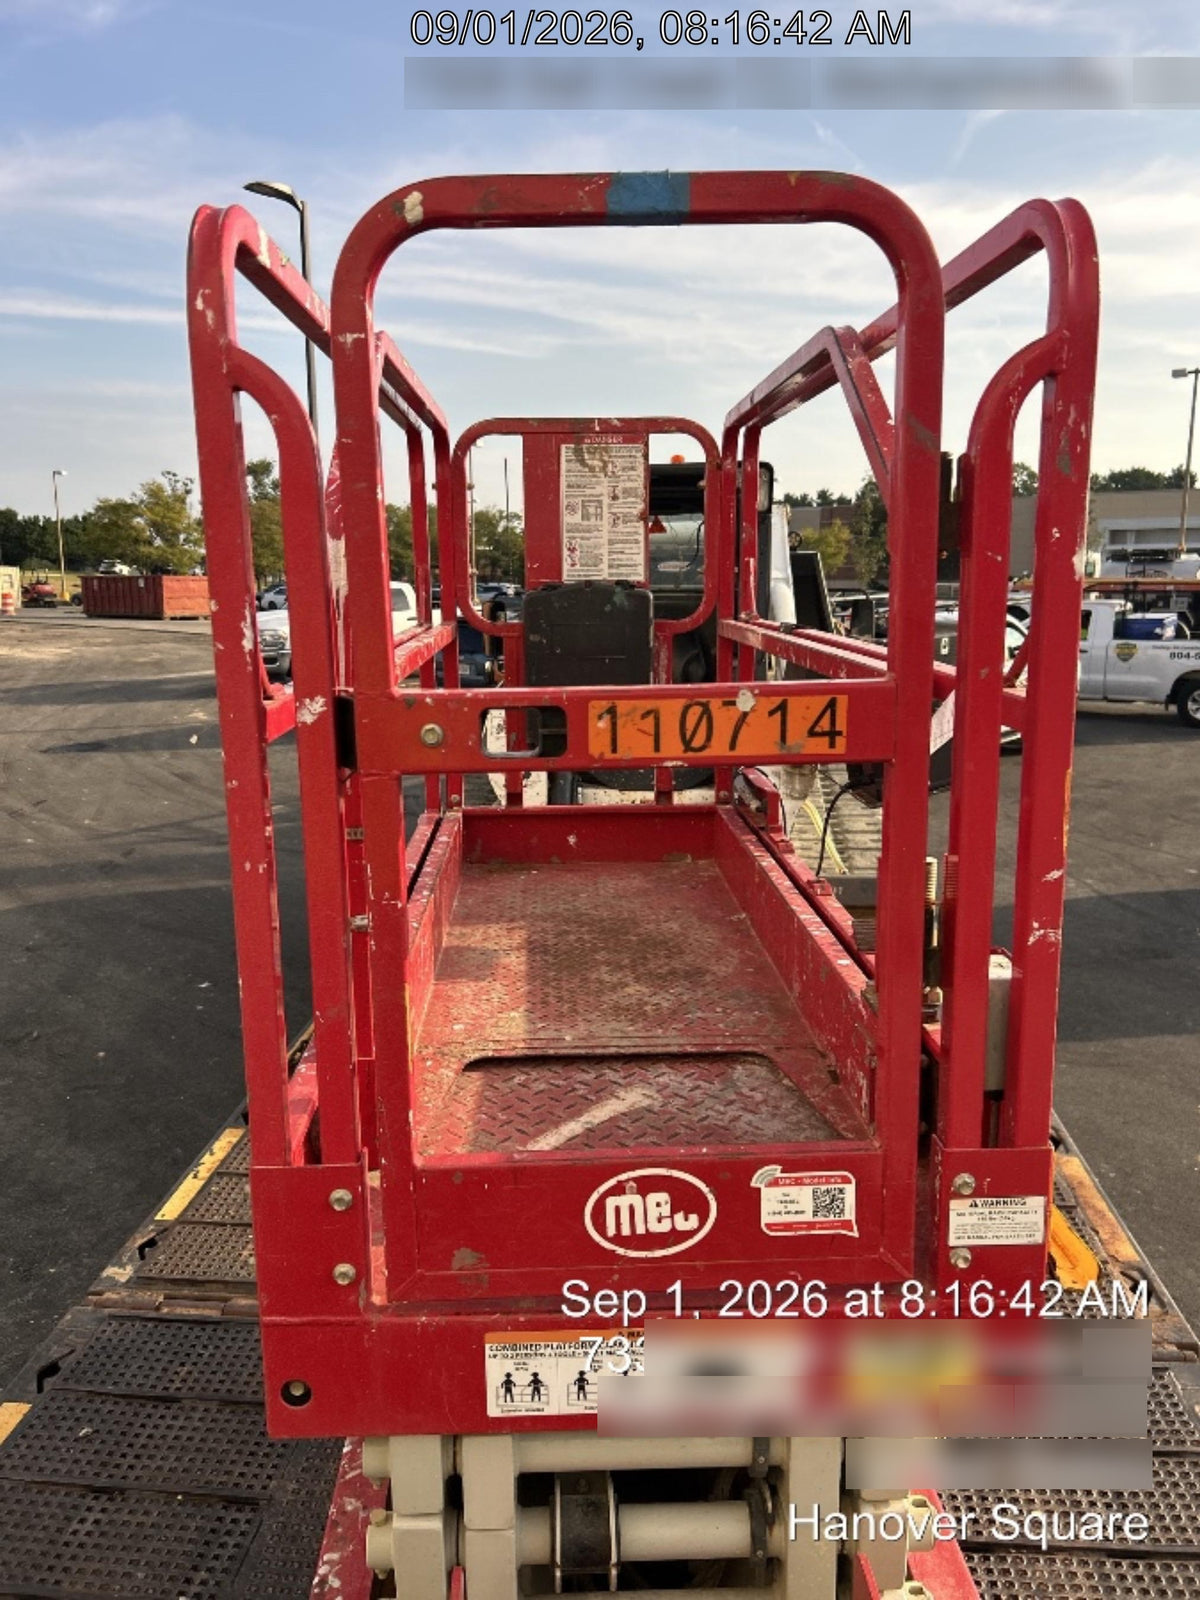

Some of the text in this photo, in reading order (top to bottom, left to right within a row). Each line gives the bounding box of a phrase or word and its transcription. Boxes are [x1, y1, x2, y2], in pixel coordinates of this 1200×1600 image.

[597, 696, 844, 754] 110714
[980, 1198, 1027, 1208] WARNING
[489, 1343, 541, 1352] COMBINED
